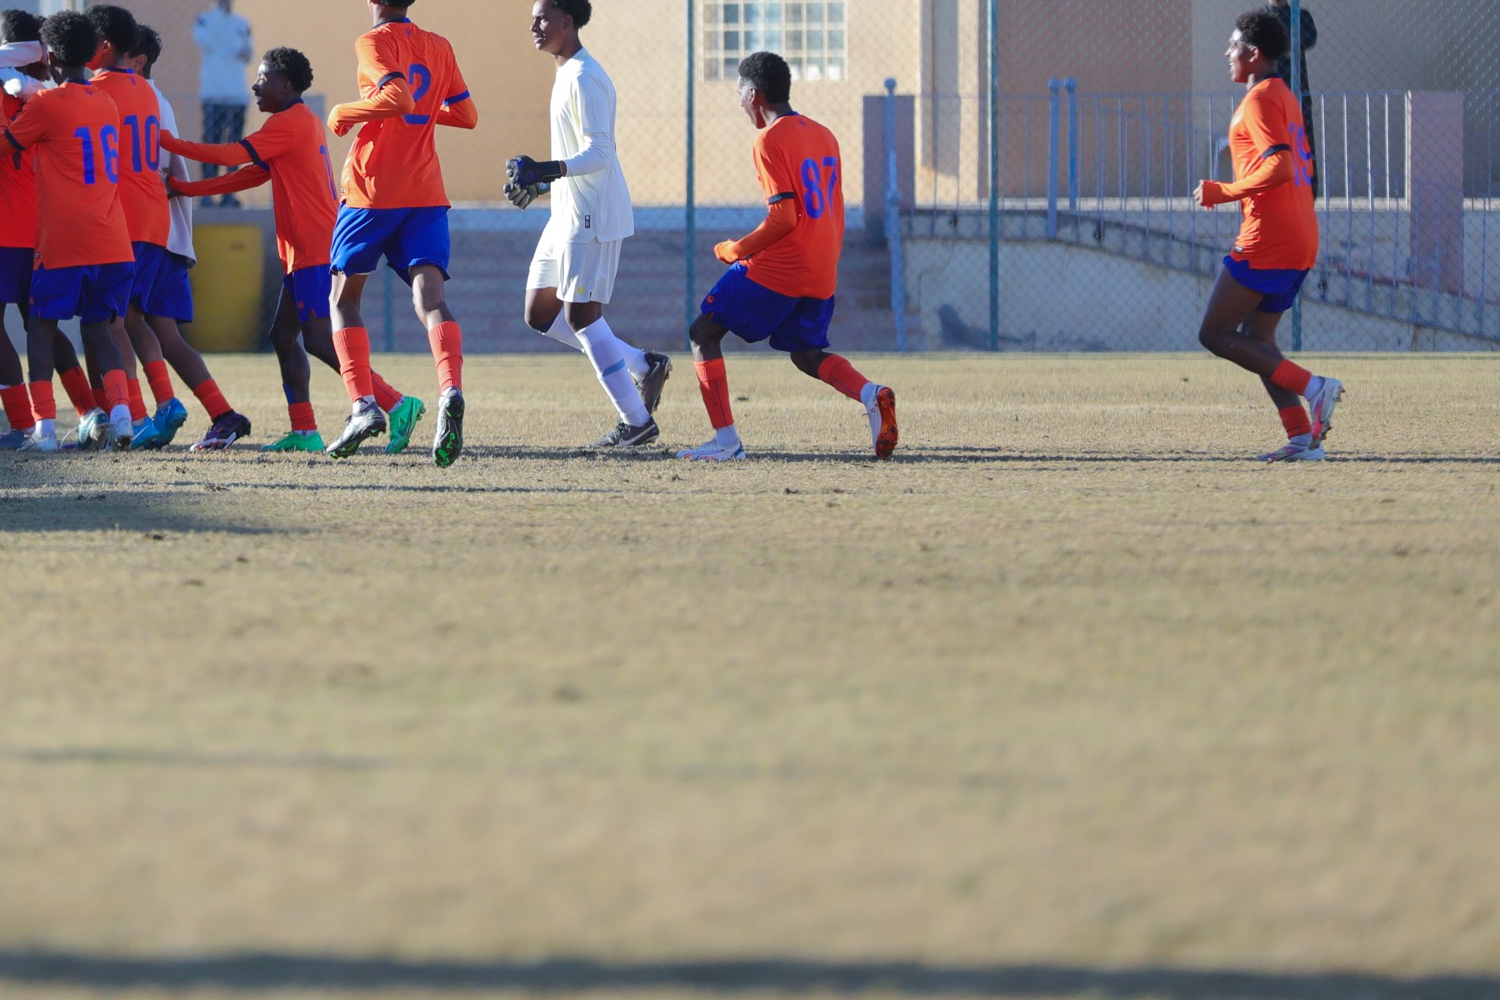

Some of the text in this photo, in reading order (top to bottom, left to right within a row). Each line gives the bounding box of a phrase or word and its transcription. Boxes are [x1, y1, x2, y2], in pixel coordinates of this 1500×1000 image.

[73, 124, 119, 184] 16
[123, 114, 160, 172] 10
[801, 156, 837, 219] 87
